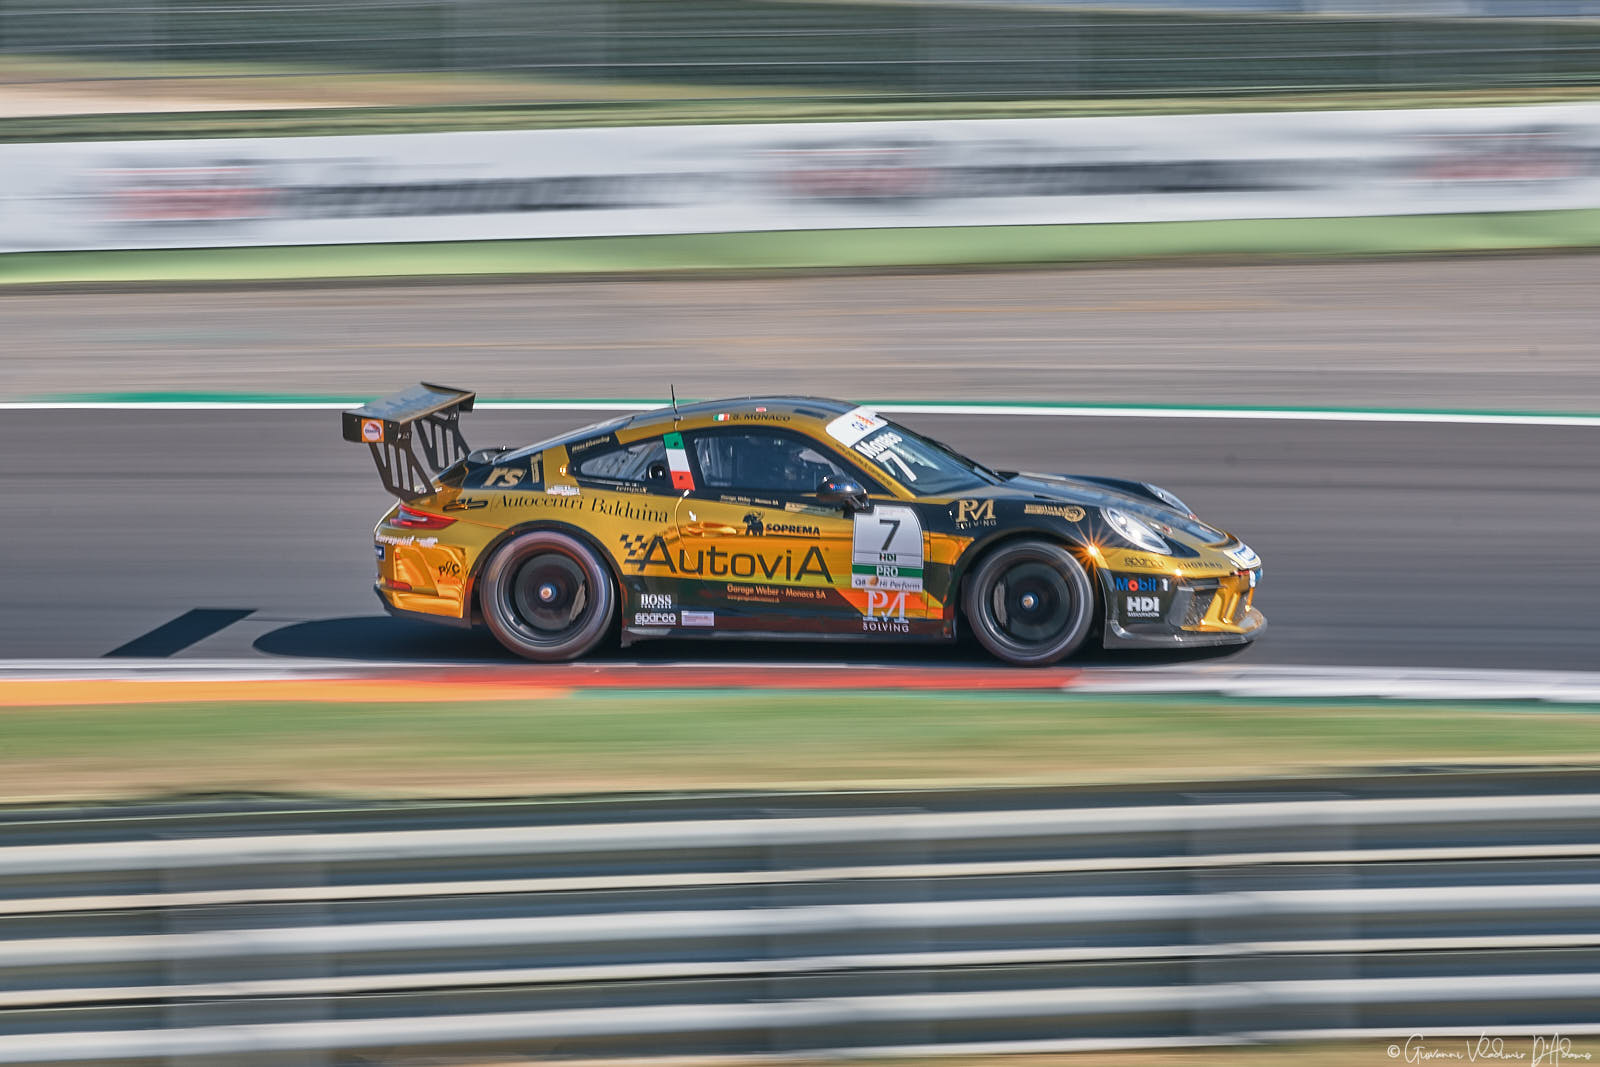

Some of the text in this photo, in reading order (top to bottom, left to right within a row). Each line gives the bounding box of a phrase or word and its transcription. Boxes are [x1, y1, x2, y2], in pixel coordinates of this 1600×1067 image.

[744, 413, 791, 422] MONACO
[875, 449, 918, 482] 7
[498, 495, 584, 510] Autocentri
[591, 497, 668, 523] Balduina
[766, 523, 820, 536] SOPREMA
[879, 519, 901, 551] 7
[879, 552, 897, 562] HDI
[876, 565, 898, 577] PRO
[726, 583, 754, 595] Garage
[755, 586, 780, 596] Weber
[785, 588, 814, 598] Monaco
[815, 589, 827, 600] SA
[1115, 577, 1169, 592] Mobil 1
[640, 593, 672, 604] BOSS
[1127, 596, 1160, 612] HDI
[634, 612, 677, 626] sparco
[862, 622, 910, 633] SOLVING
